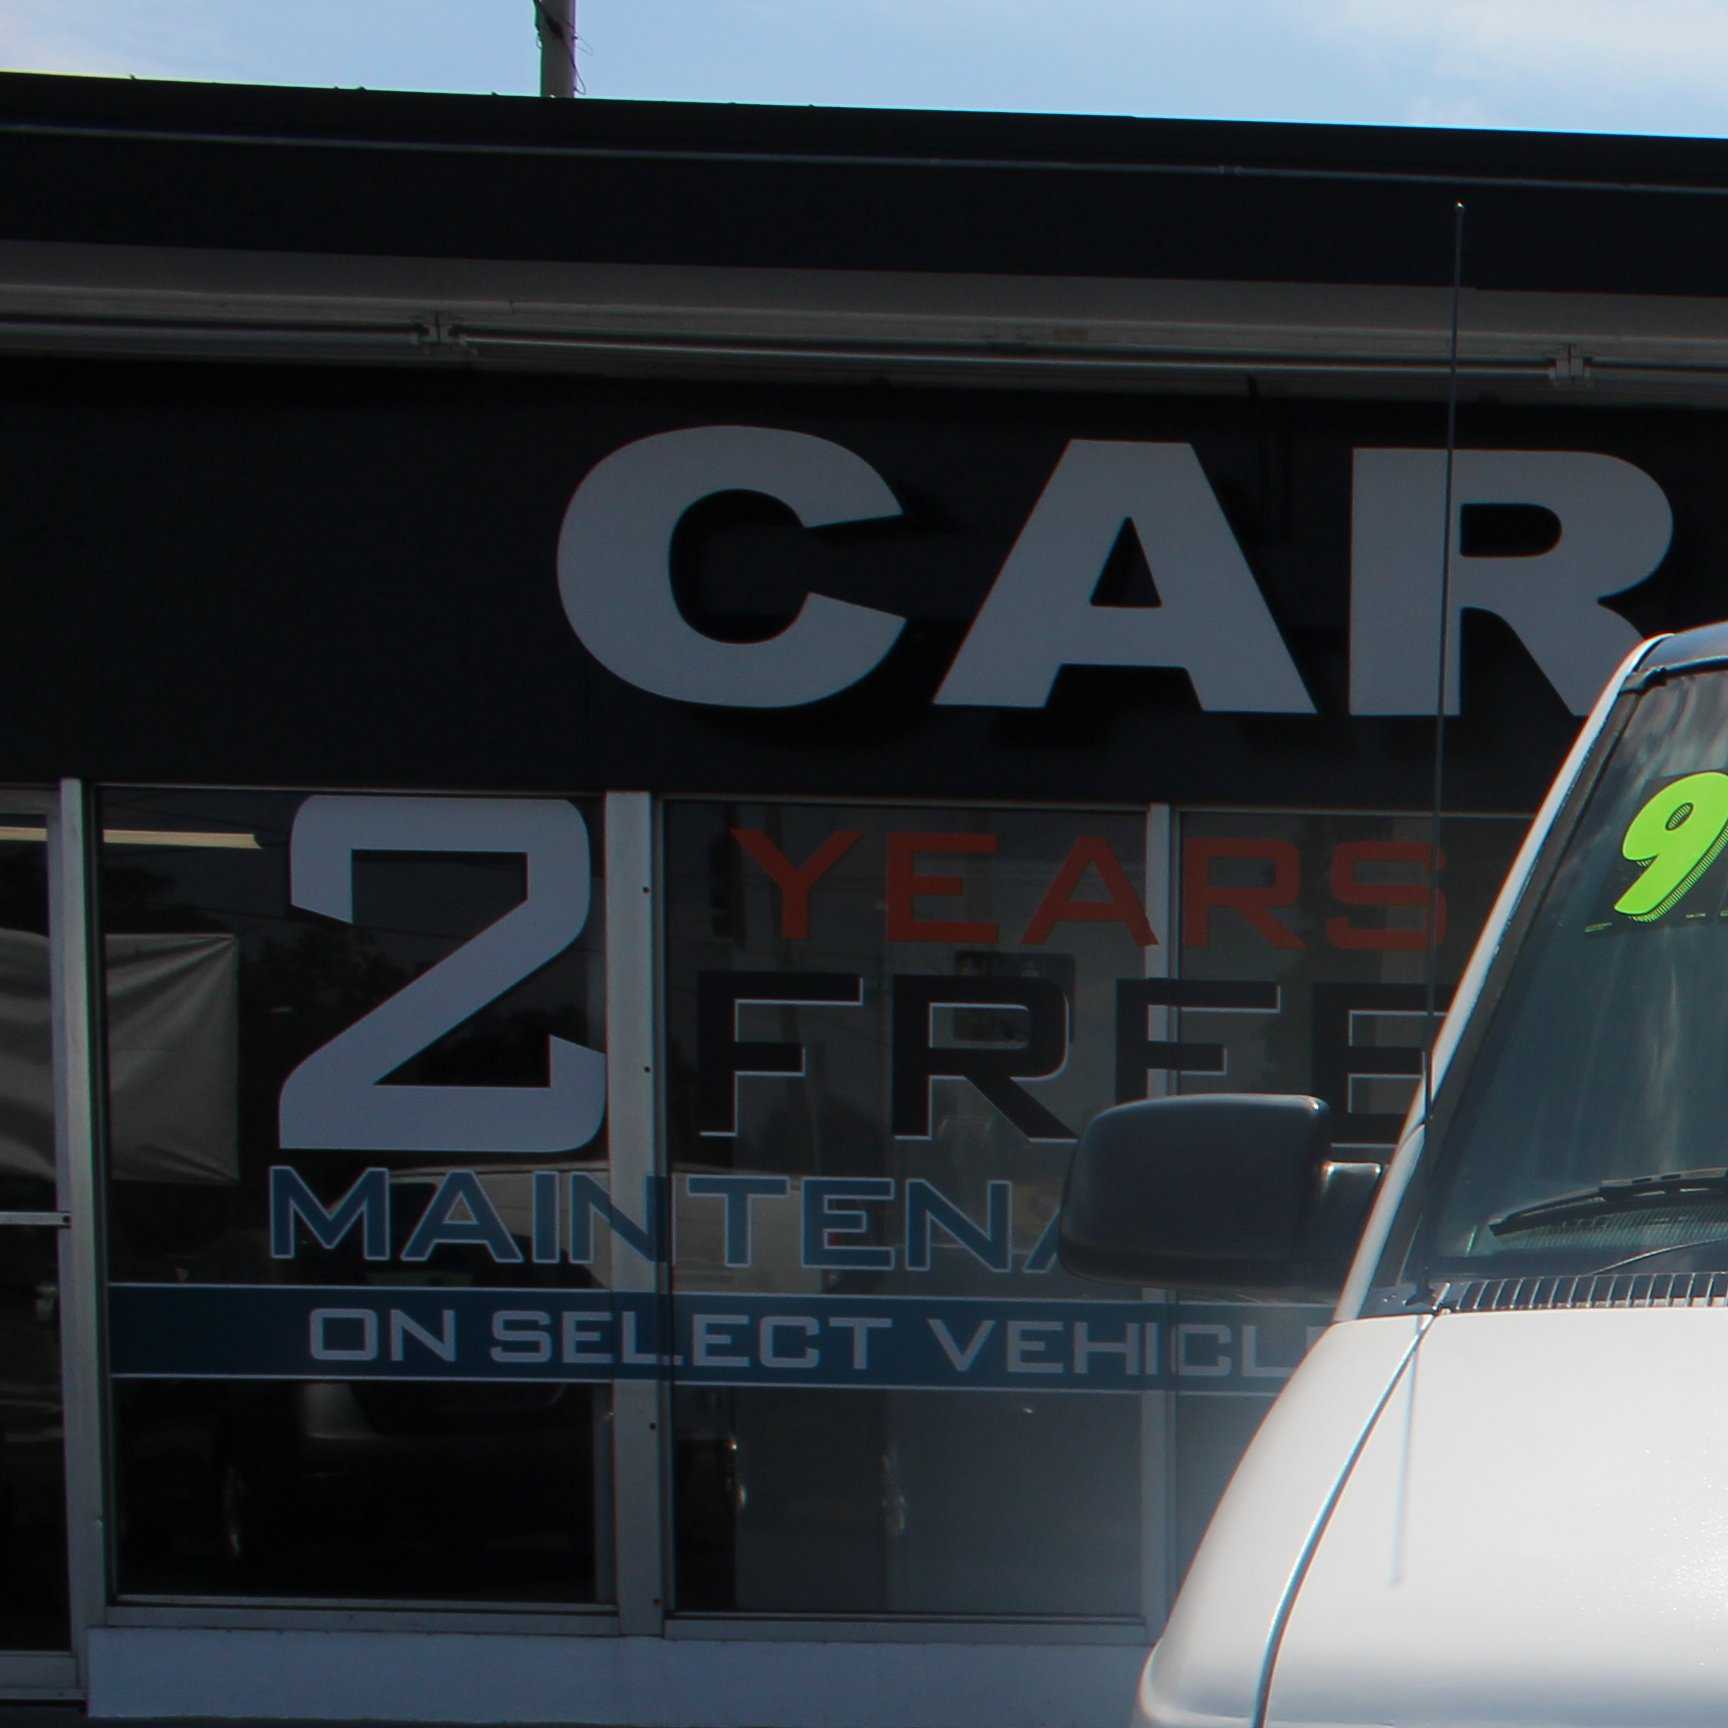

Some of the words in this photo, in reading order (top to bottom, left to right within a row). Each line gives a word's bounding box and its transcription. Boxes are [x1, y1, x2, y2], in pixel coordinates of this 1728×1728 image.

[556, 424, 1674, 718] CAR
[730, 826, 1447, 951] YEARS
[279, 794, 606, 1153] 2
[698, 970, 1458, 1149] FREE
[268, 1166, 1062, 1275] MAINTEN
[309, 1308, 456, 1363] ON
[490, 1310, 893, 1371] SELECT
[926, 1318, 1334, 1378] VEHICL
